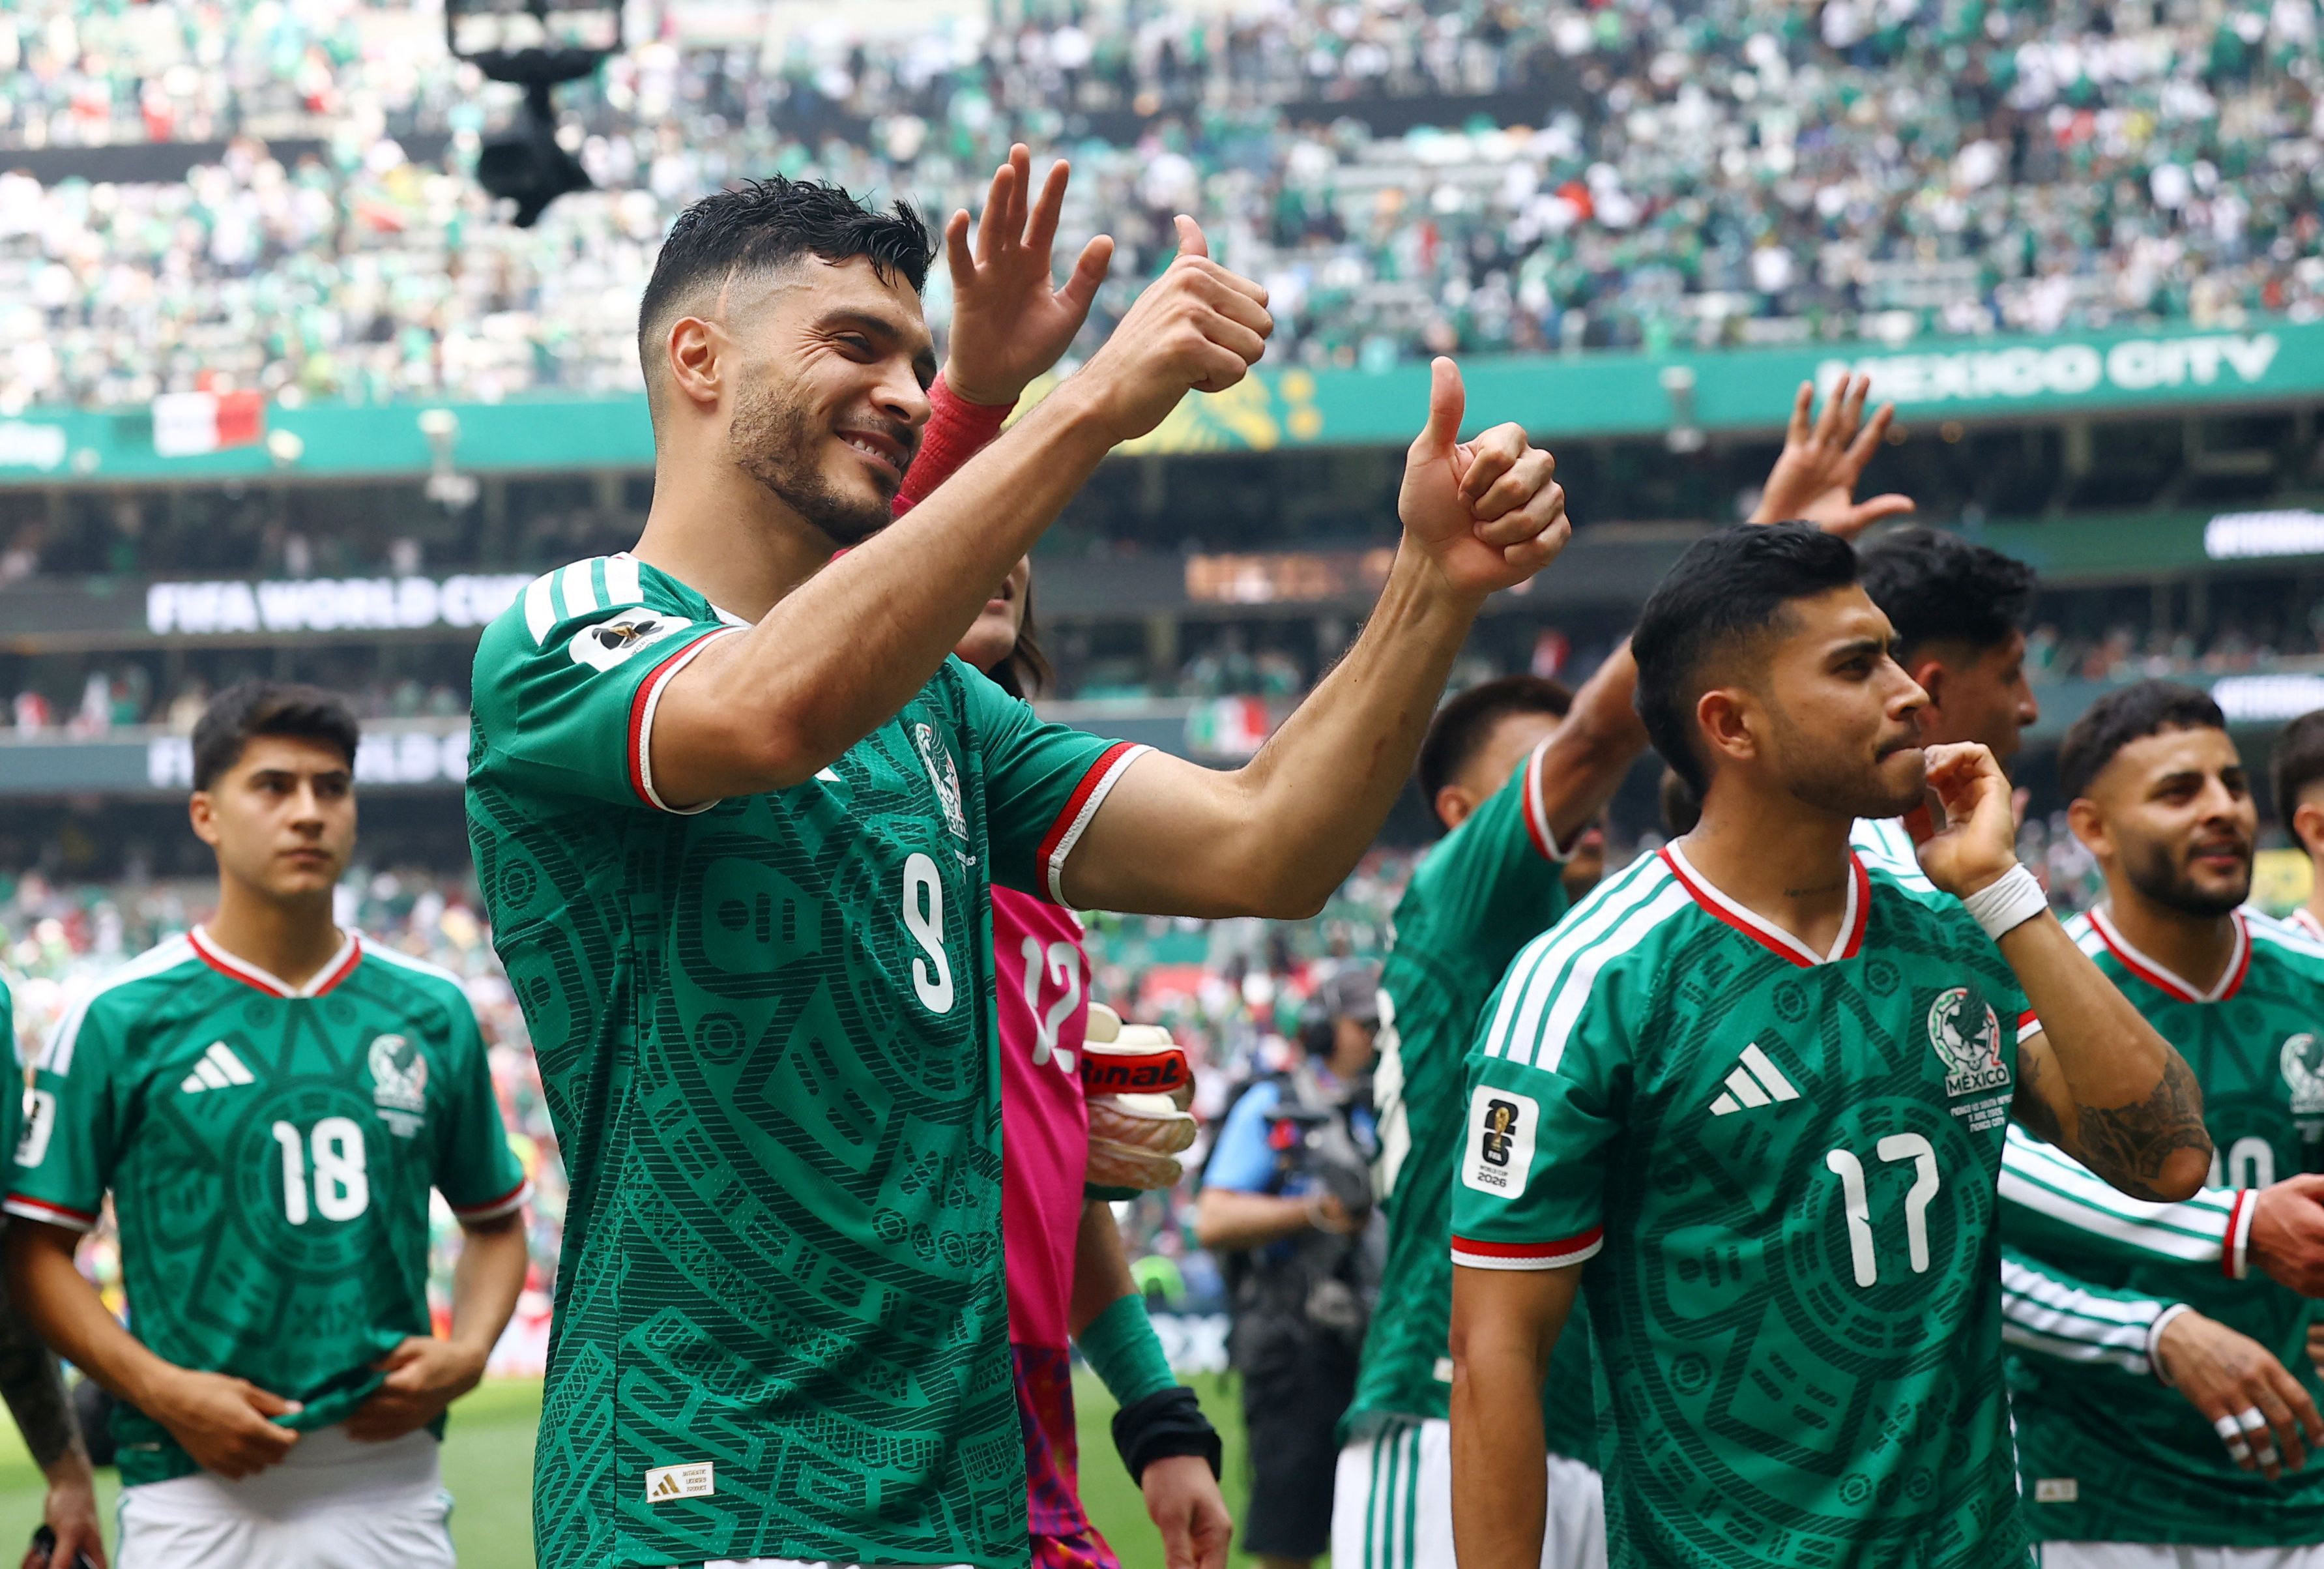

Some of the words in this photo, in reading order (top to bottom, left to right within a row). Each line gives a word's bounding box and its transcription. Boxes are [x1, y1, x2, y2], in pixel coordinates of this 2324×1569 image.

[1816, 344, 2102, 403] MEXICO
[2108, 334, 2280, 389] CITY
[147, 581, 259, 634] FIFA
[260, 576, 439, 632] WORLD
[903, 853, 954, 1014] 9
[1021, 935, 1082, 1074] 12
[1948, 1068, 2007, 1094] MÉXICO
[272, 1116, 370, 1225] 18
[1477, 1171, 1507, 1188] 2026
[1826, 1132, 1940, 1288] 17
